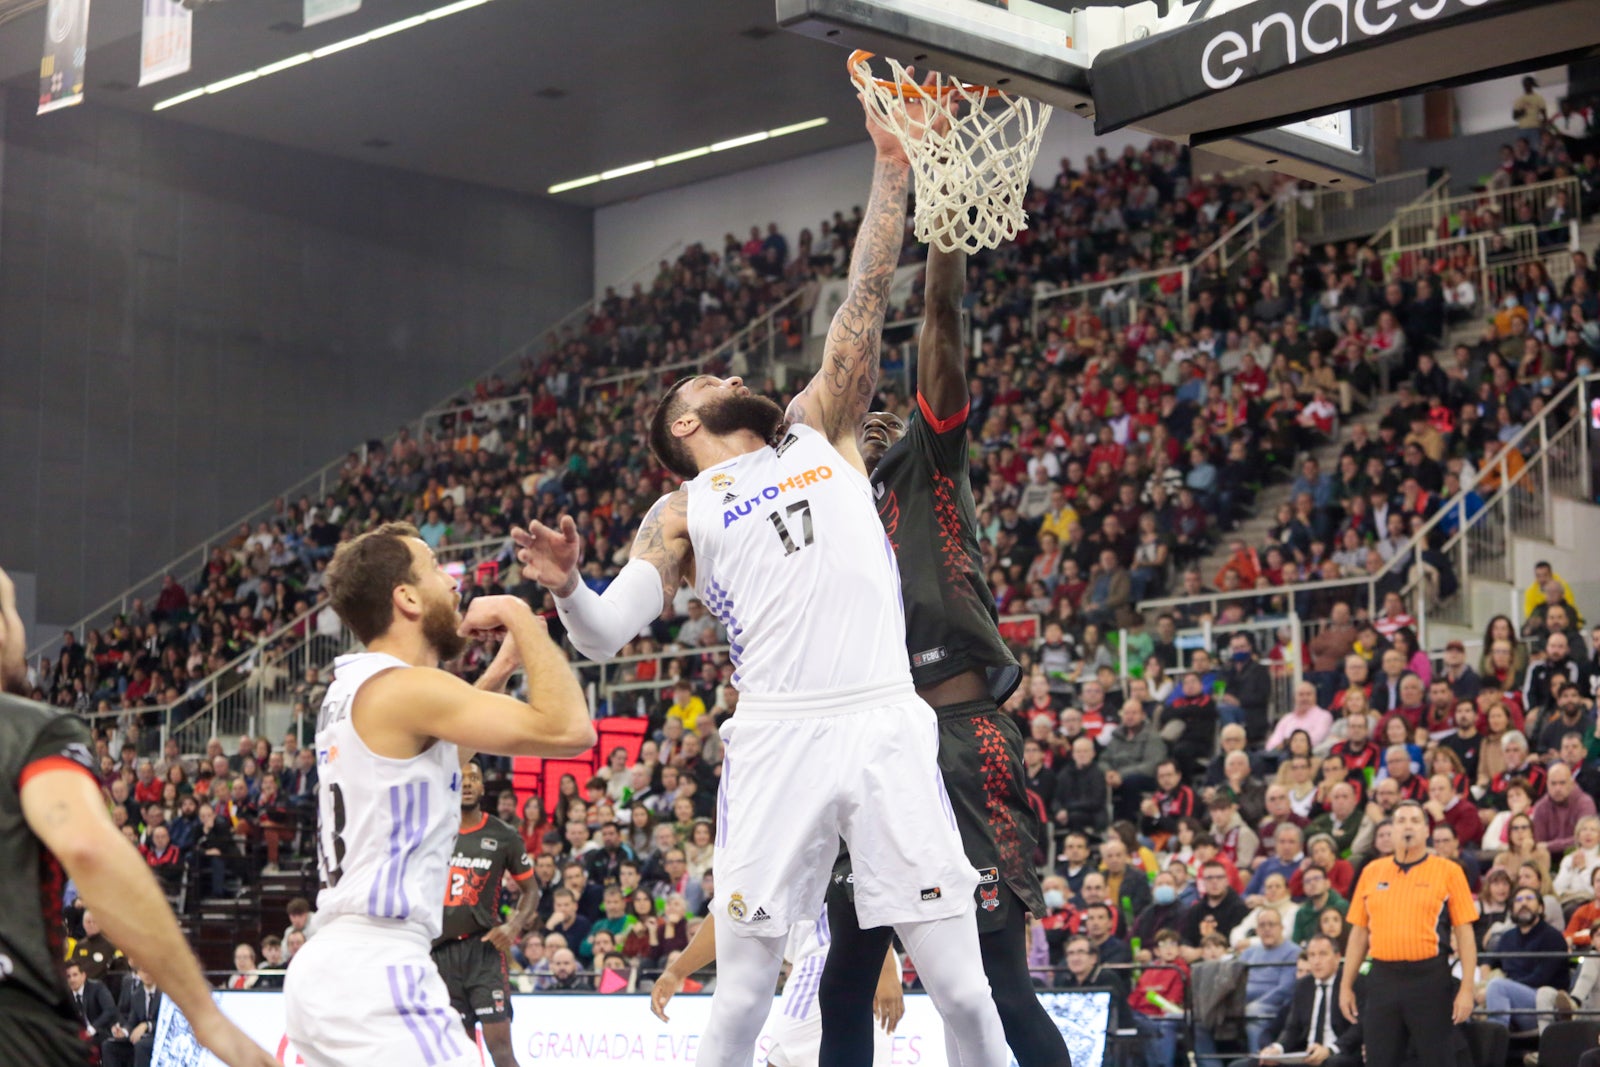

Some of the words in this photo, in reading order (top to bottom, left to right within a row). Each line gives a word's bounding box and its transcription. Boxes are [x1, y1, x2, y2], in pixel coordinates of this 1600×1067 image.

[723, 465, 833, 529] AUTOHERO
[766, 499, 815, 557] 17
[923, 891, 938, 900] acb
[528, 1031, 645, 1060] GRANADA
